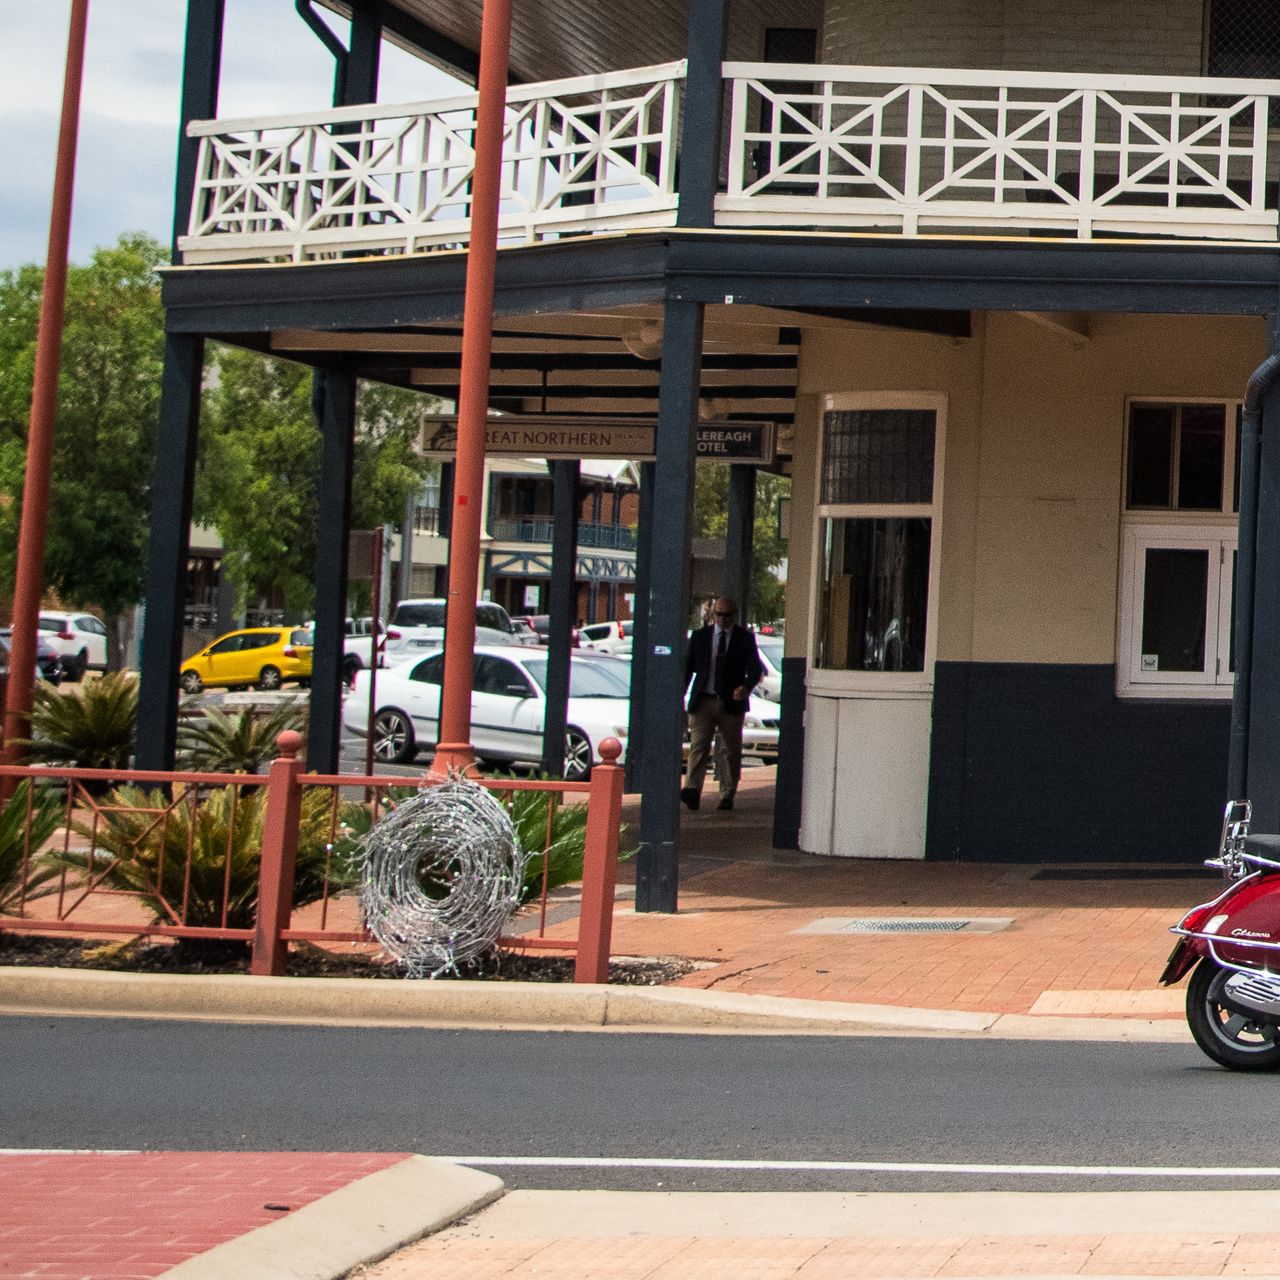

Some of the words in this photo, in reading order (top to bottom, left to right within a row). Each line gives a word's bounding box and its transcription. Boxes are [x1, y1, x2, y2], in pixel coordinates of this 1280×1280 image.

[523, 431, 612, 446] NORTHERN
[696, 431, 752, 441] LEREAGH
[697, 442, 728, 452] OTEL
